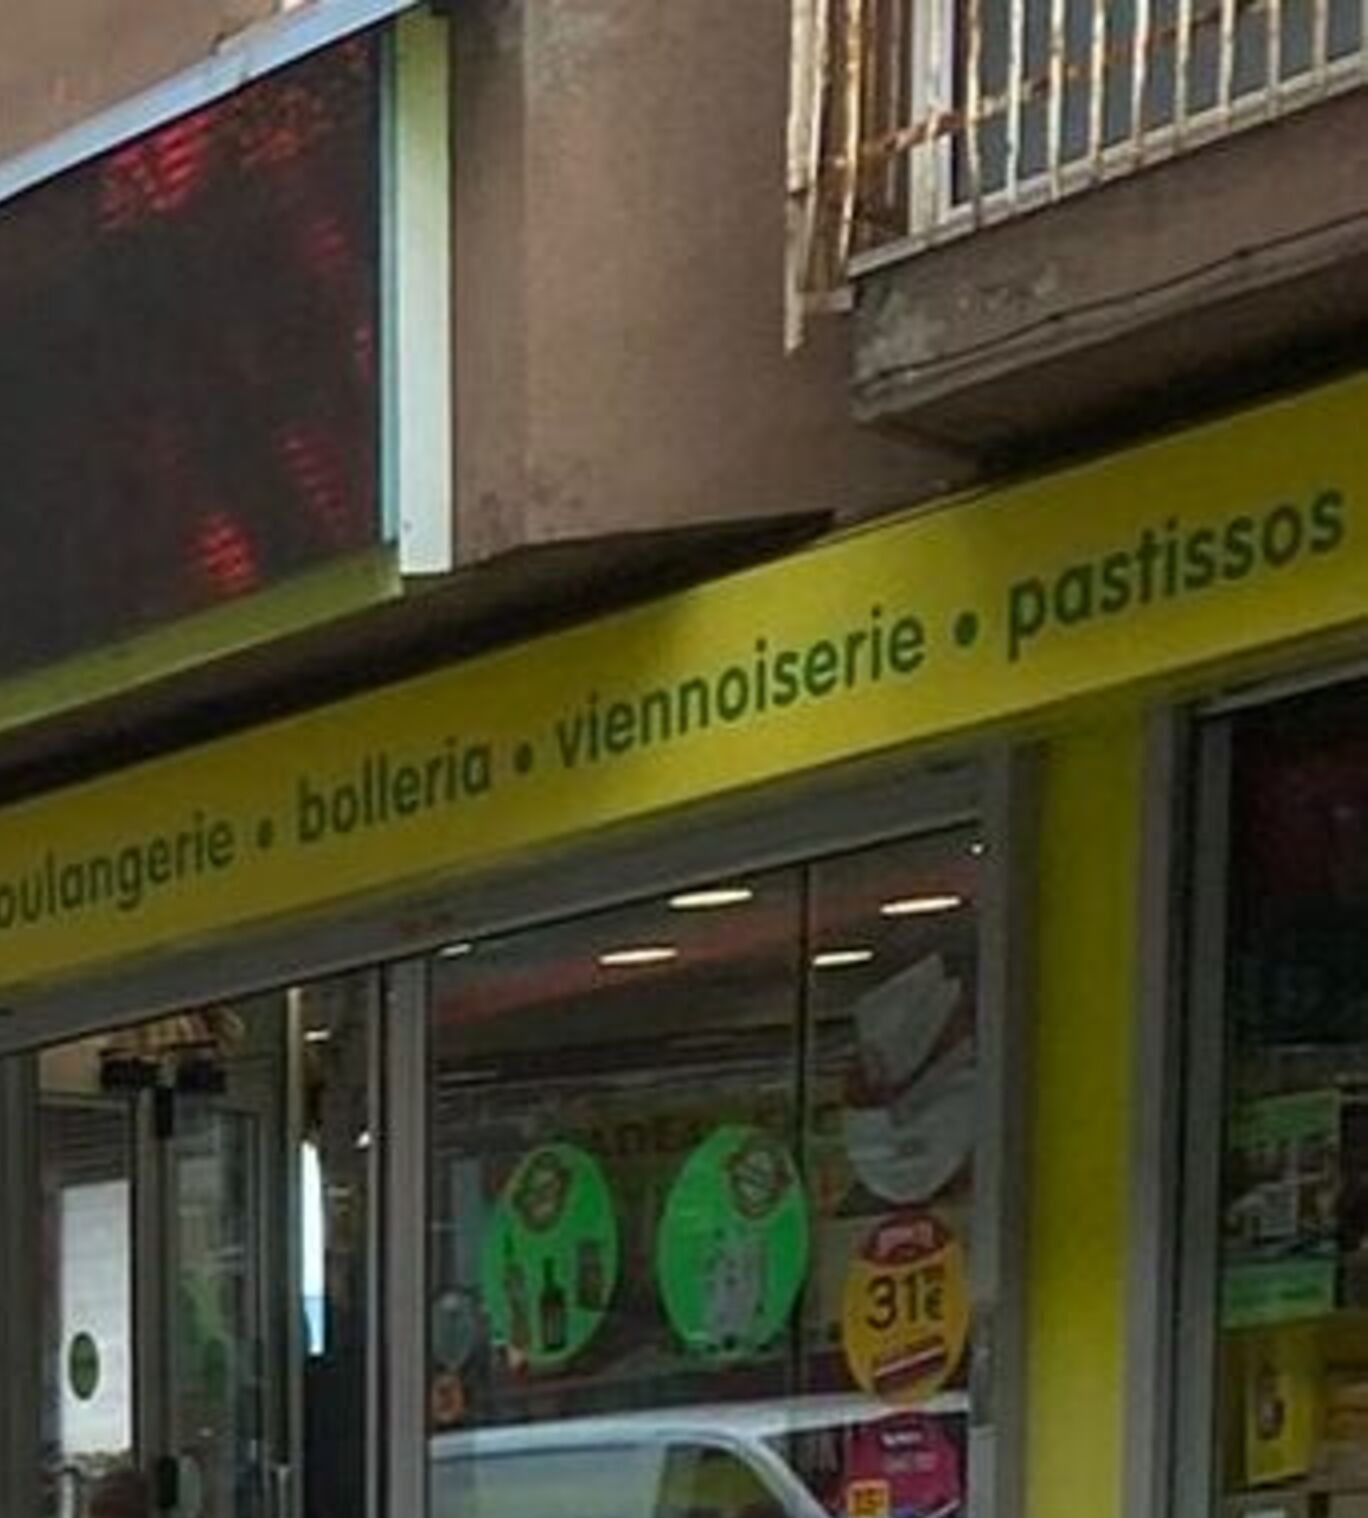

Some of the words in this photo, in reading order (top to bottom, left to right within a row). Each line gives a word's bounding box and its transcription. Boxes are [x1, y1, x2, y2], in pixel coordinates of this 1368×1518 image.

[297, 740, 493, 845] bolleria
[555, 604, 927, 769] viennoiserie
[1006, 487, 1347, 661] pastissos
